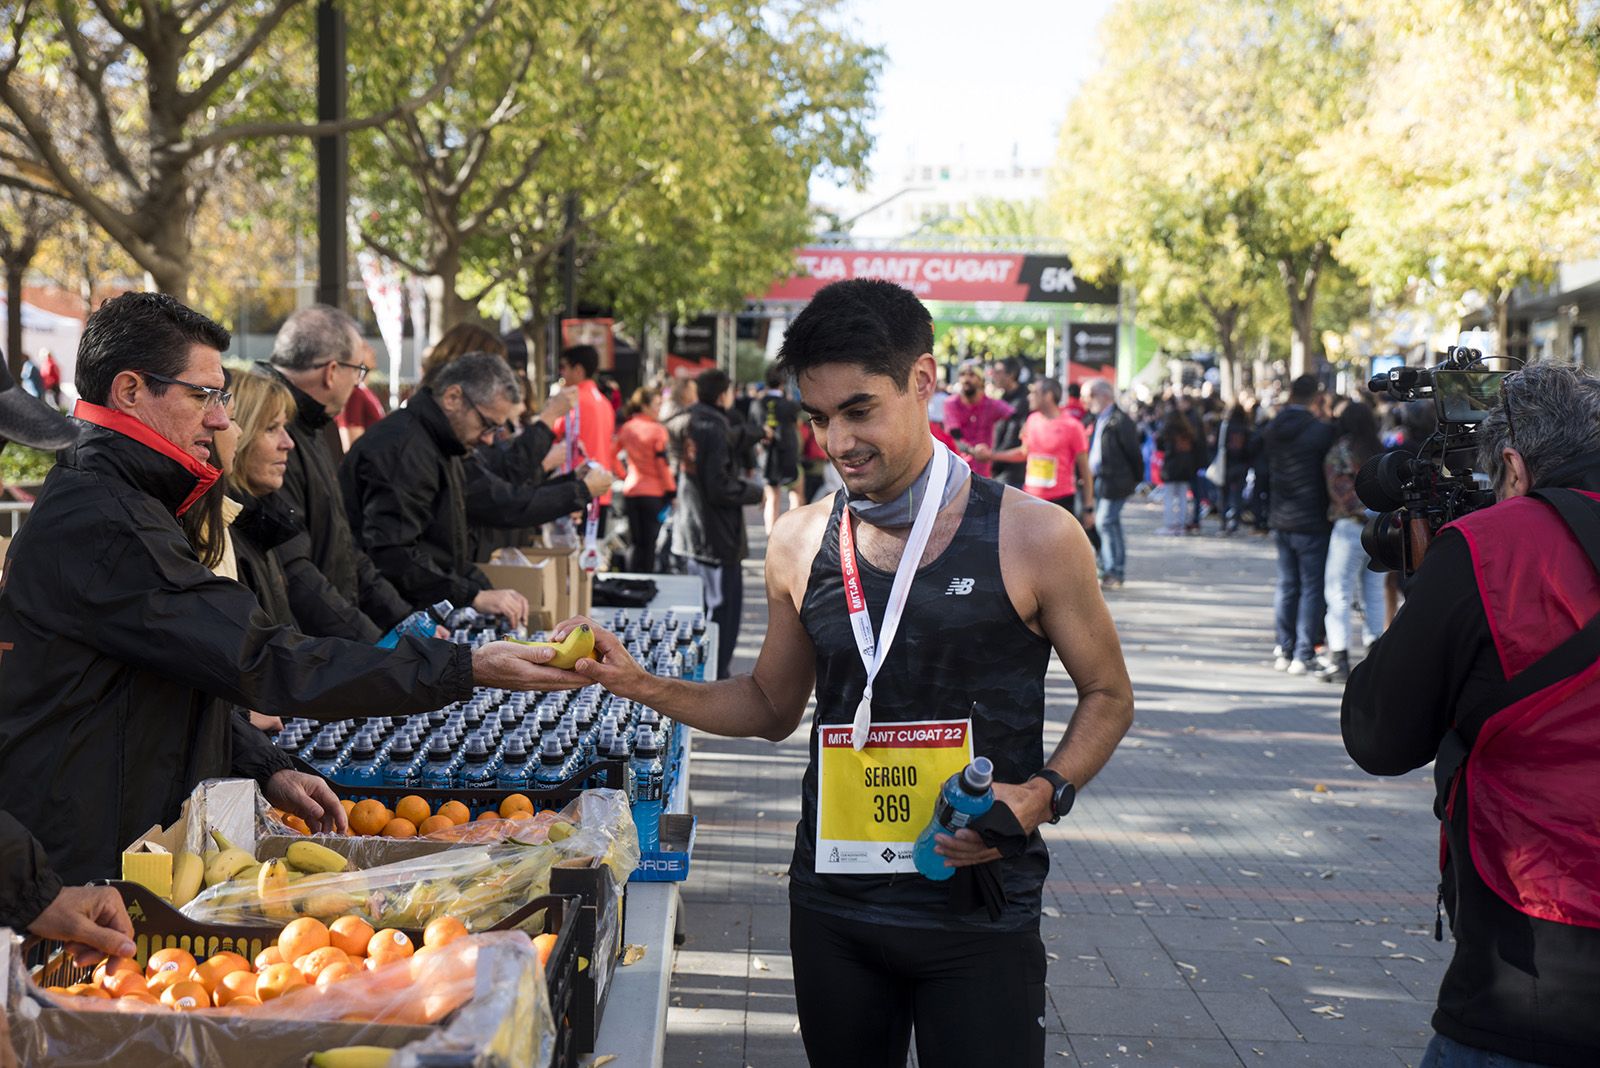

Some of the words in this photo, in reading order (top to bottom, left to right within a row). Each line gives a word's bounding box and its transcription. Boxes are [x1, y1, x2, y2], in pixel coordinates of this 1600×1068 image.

[852, 256, 921, 280] SANT
[922, 258, 1013, 283] CUGAT
[1040, 267, 1077, 292] 5K
[844, 548, 854, 576] SANT
[849, 577, 862, 609] MITJA
[828, 733, 853, 744] MITJ
[867, 731, 895, 743] ANT
[897, 728, 944, 742] CUGAT
[944, 728, 962, 740] 22
[865, 766, 917, 787] SERGIO
[873, 794, 910, 823] 369
